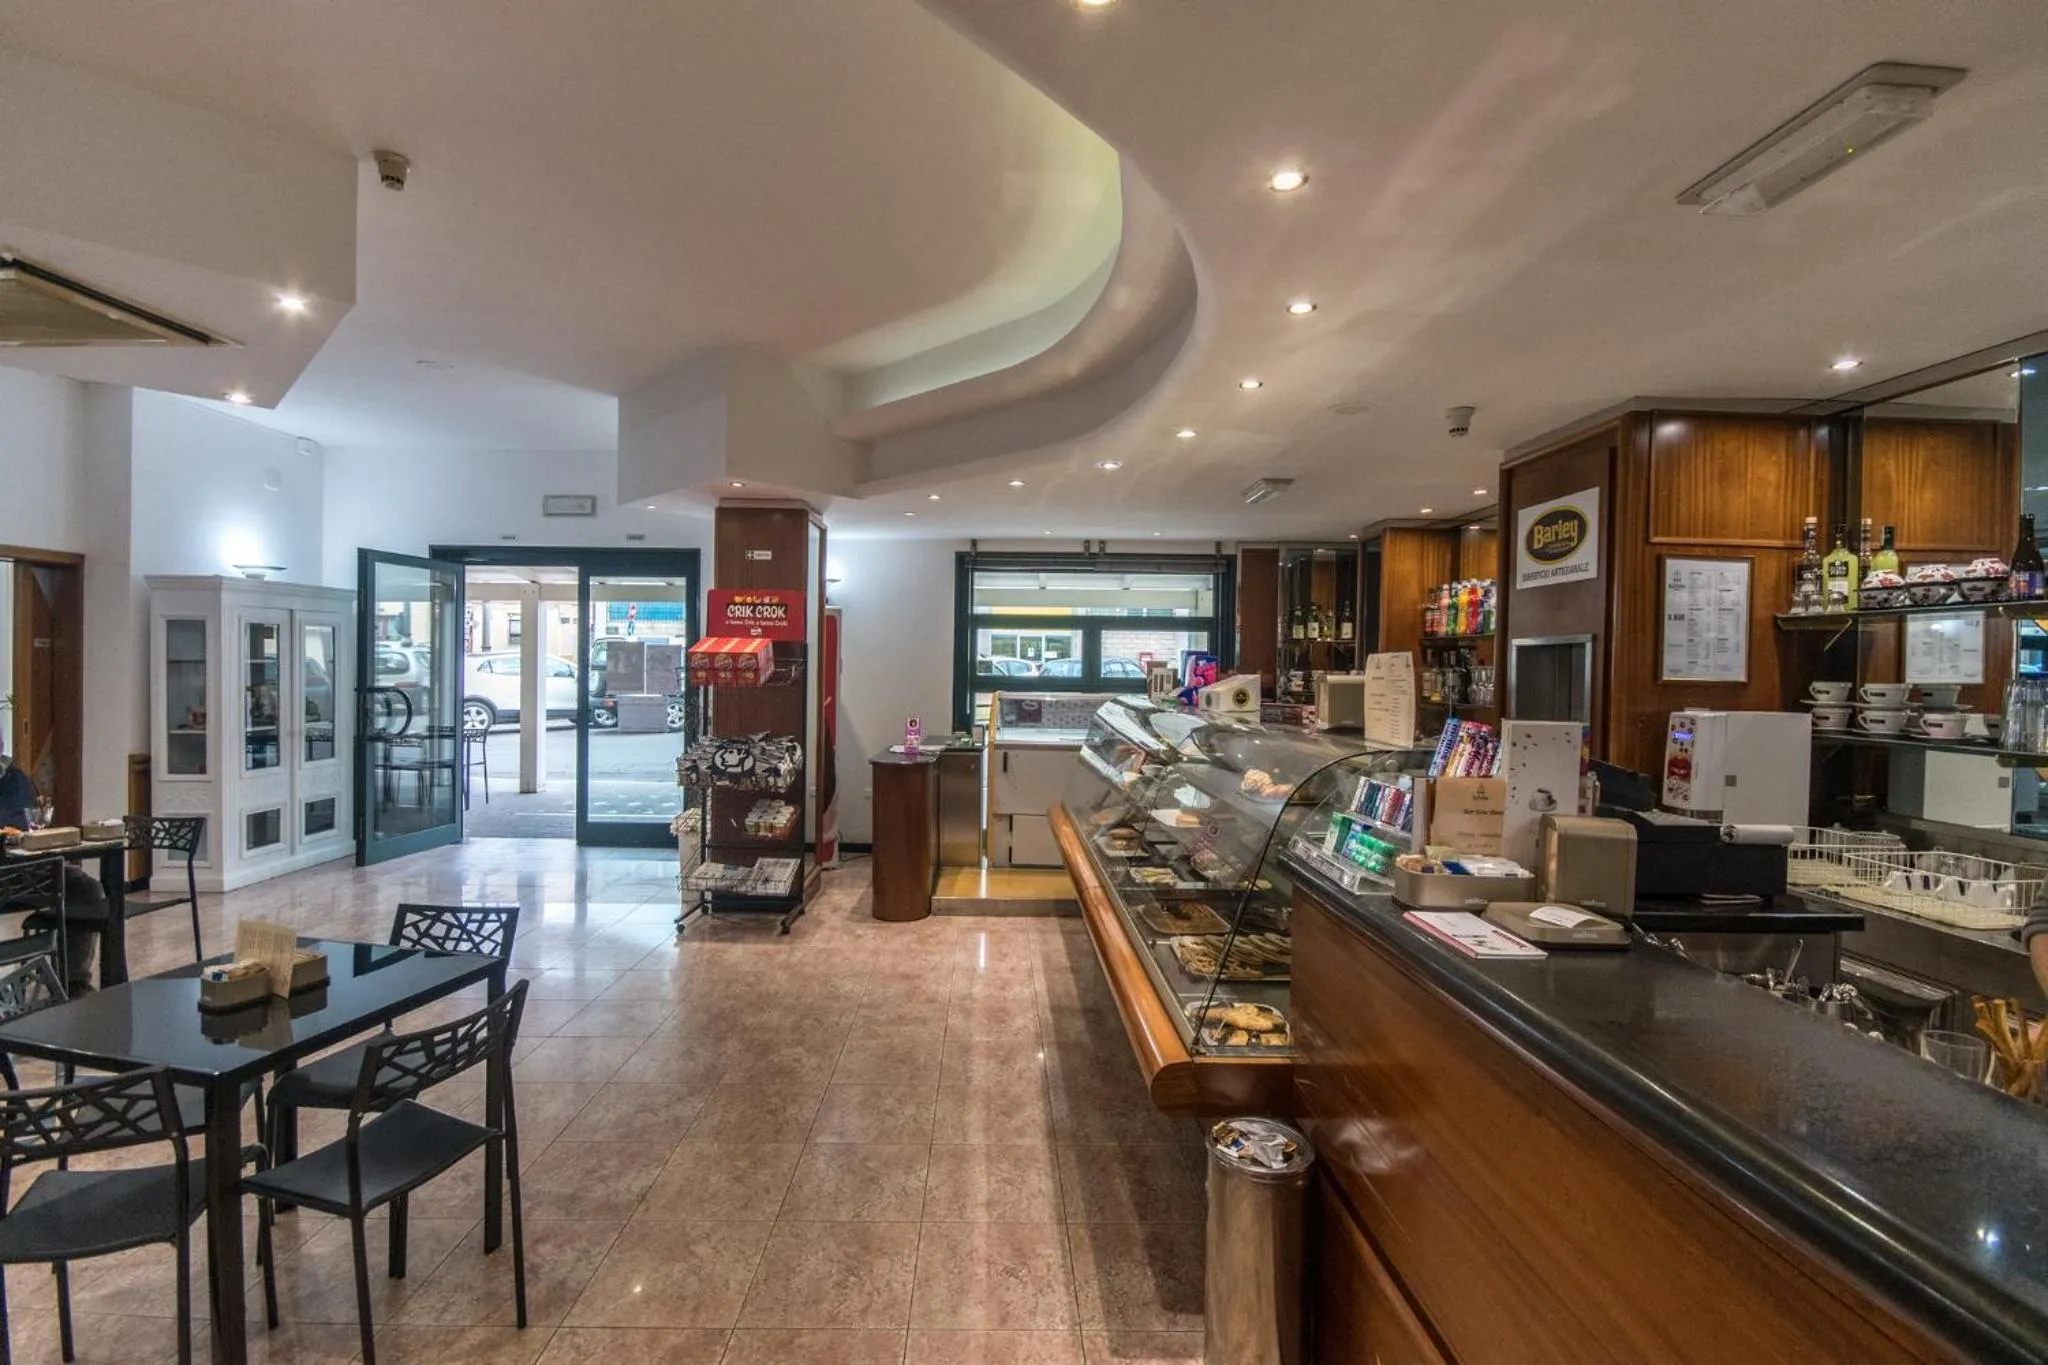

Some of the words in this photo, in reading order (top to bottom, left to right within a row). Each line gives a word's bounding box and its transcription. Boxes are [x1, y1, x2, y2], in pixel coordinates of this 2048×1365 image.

[1532, 519, 1579, 549] Barley
[727, 604, 754, 618] CRIK
[755, 604, 786, 618] CROK
